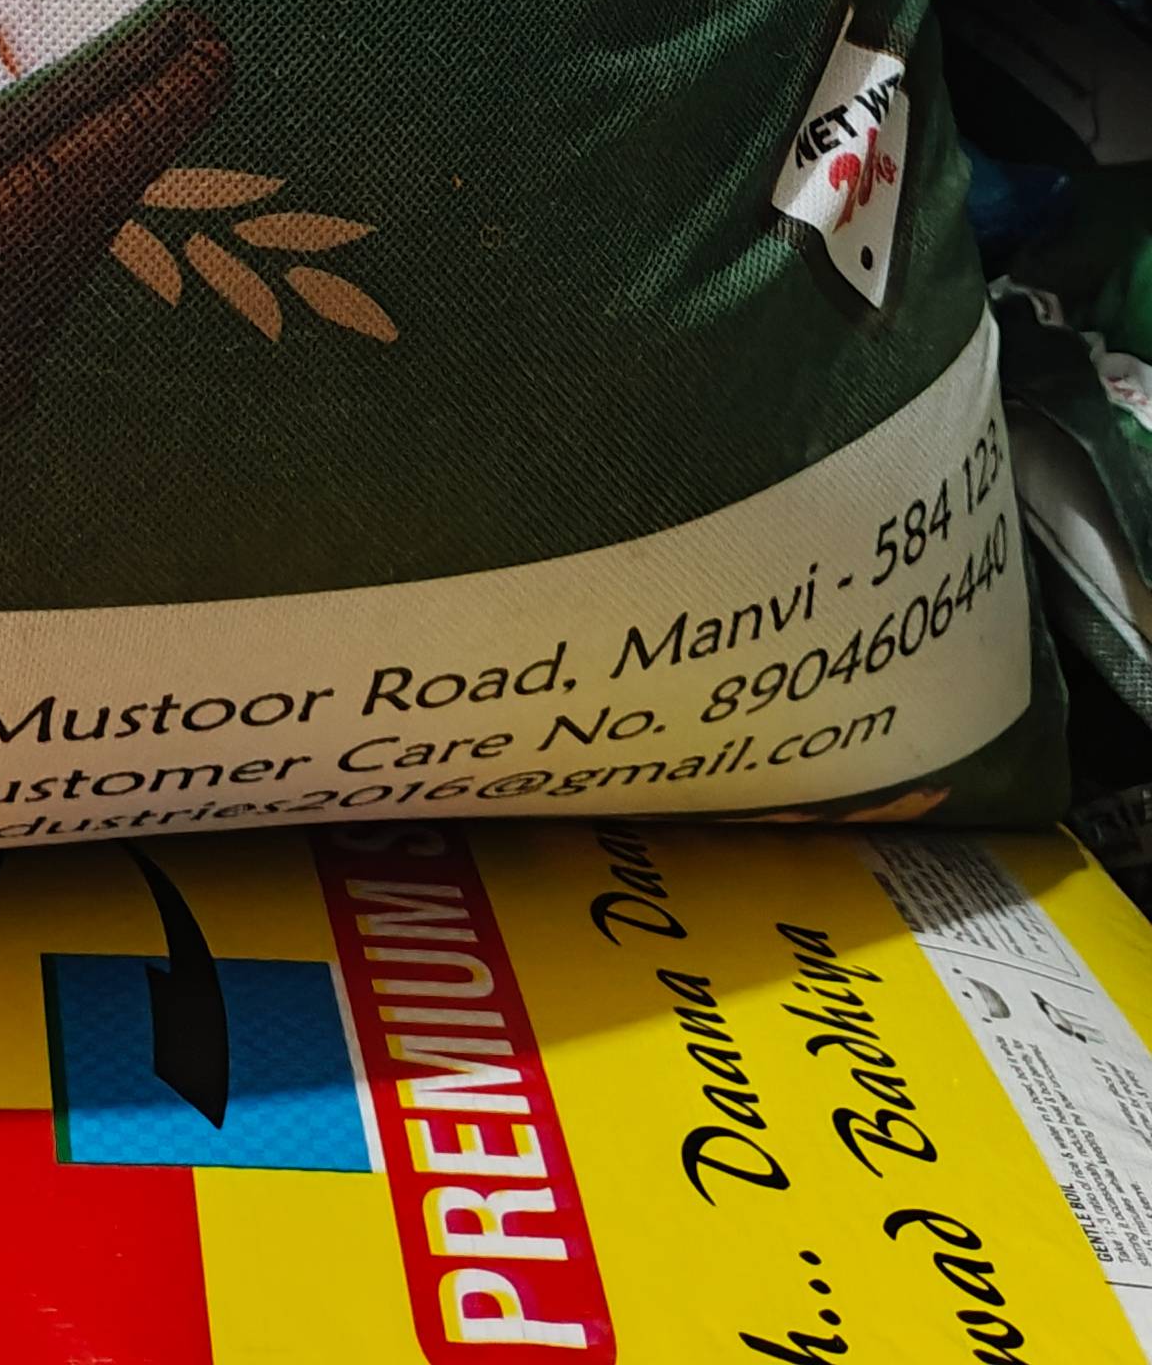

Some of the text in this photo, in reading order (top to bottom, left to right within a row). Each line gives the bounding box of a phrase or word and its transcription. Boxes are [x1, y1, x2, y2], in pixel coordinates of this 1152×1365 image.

[795, 103, 859, 168] NET
[335, 731, 514, 773] Care
[538, 707, 668, 753] No.
[698, 513, 1008, 725] 8904606440
[363, 641, 578, 715] Road,
[609, 563, 819, 679] Manvi
[870, 477, 953, 589] 584
[345, 877, 590, 1351] PREMIUM
[656, 966, 792, 1207] Daana
[774, 921, 940, 1181] Badhiya
[1058, 1182, 1114, 1262] GENTLE BOIL
